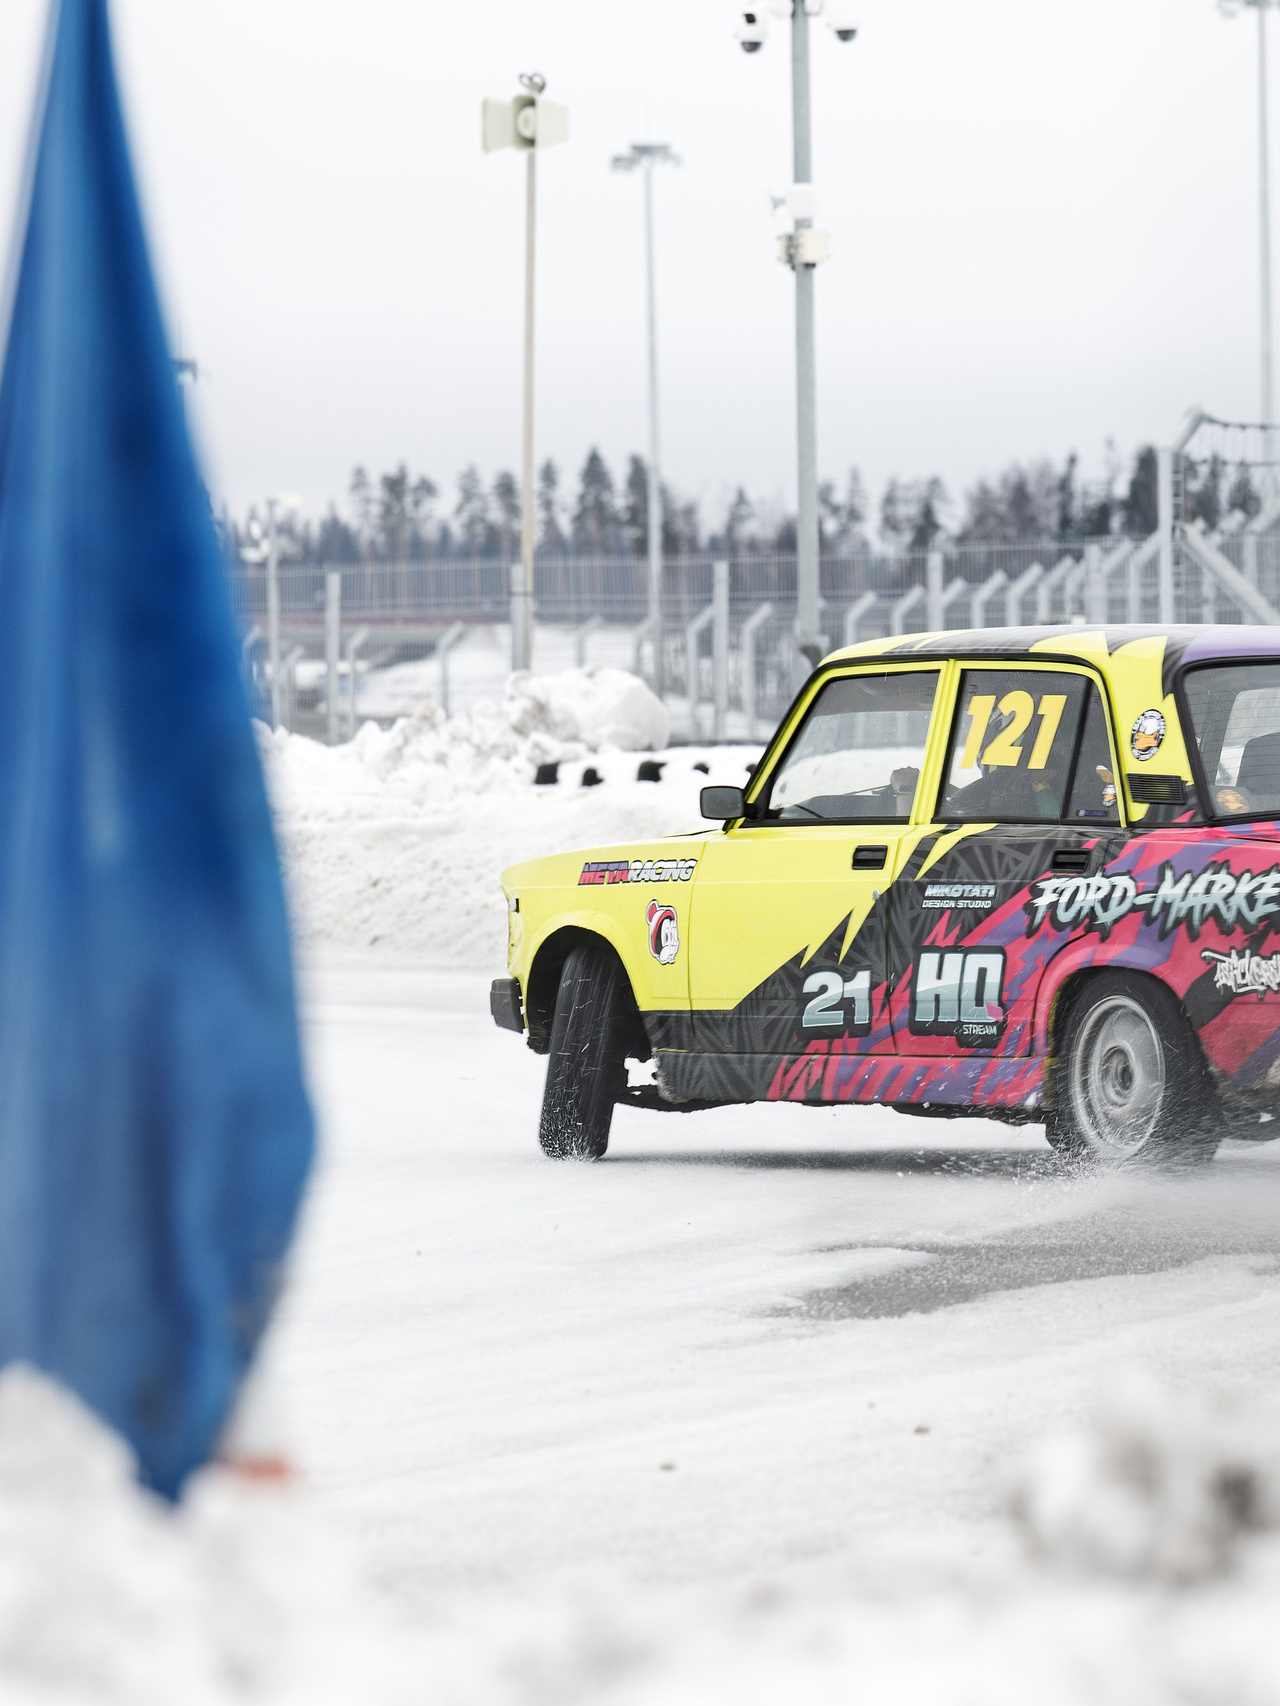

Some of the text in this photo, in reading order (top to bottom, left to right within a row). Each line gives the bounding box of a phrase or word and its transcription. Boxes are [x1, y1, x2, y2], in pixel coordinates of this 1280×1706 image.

[959, 690, 1068, 771] 121
[922, 900, 992, 908] DESIGN STUDIO
[803, 970, 871, 1028] 21
[915, 952, 1004, 1023] HQ
[962, 1024, 998, 1035] STREAM
